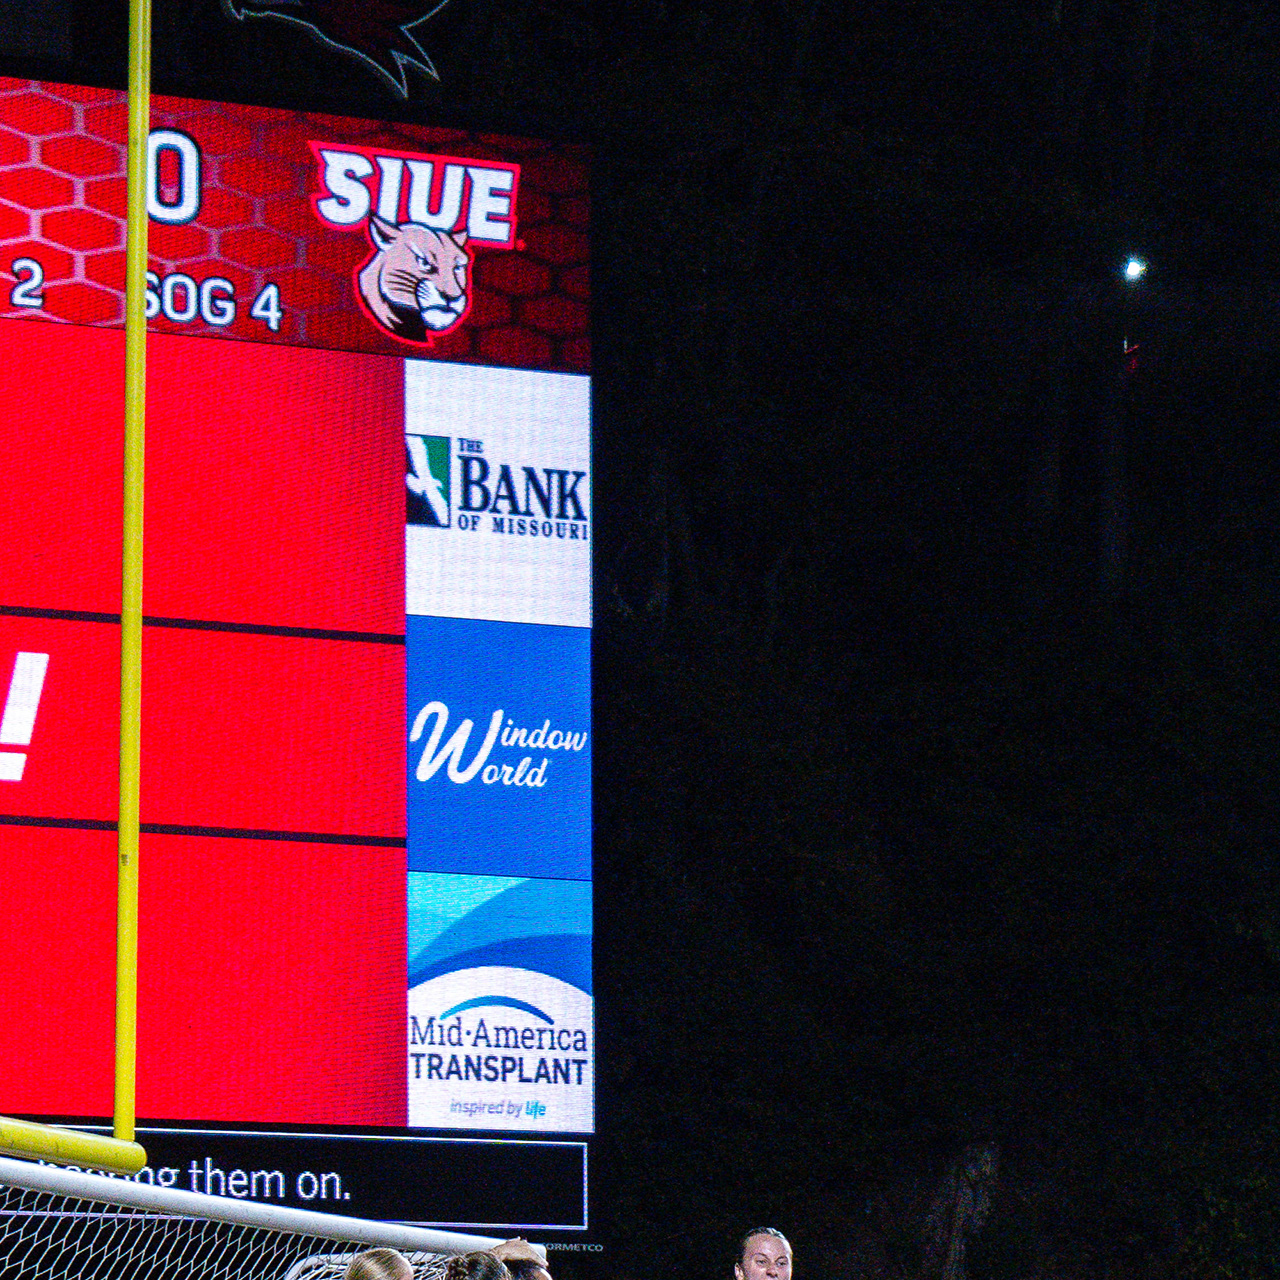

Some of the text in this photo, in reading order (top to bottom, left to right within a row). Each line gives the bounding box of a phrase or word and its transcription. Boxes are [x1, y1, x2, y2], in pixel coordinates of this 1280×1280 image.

[147, 129, 200, 224] 0
[317, 148, 519, 243] SIUE
[10, 257, 44, 308] 2
[251, 283, 282, 333] 4
[458, 437, 483, 453] THE
[458, 455, 587, 521] BANK
[458, 514, 588, 540] OF MISSOURI
[410, 701, 587, 785] Window
[410, 1053, 588, 1085] TRANSPLANT
[450, 1099, 502, 1117] inspired
[507, 1101, 522, 1118] by
[188, 1157, 285, 1197] them
[296, 1171, 350, 1200] on.
[544, 1242, 603, 1252] ORMETCO
